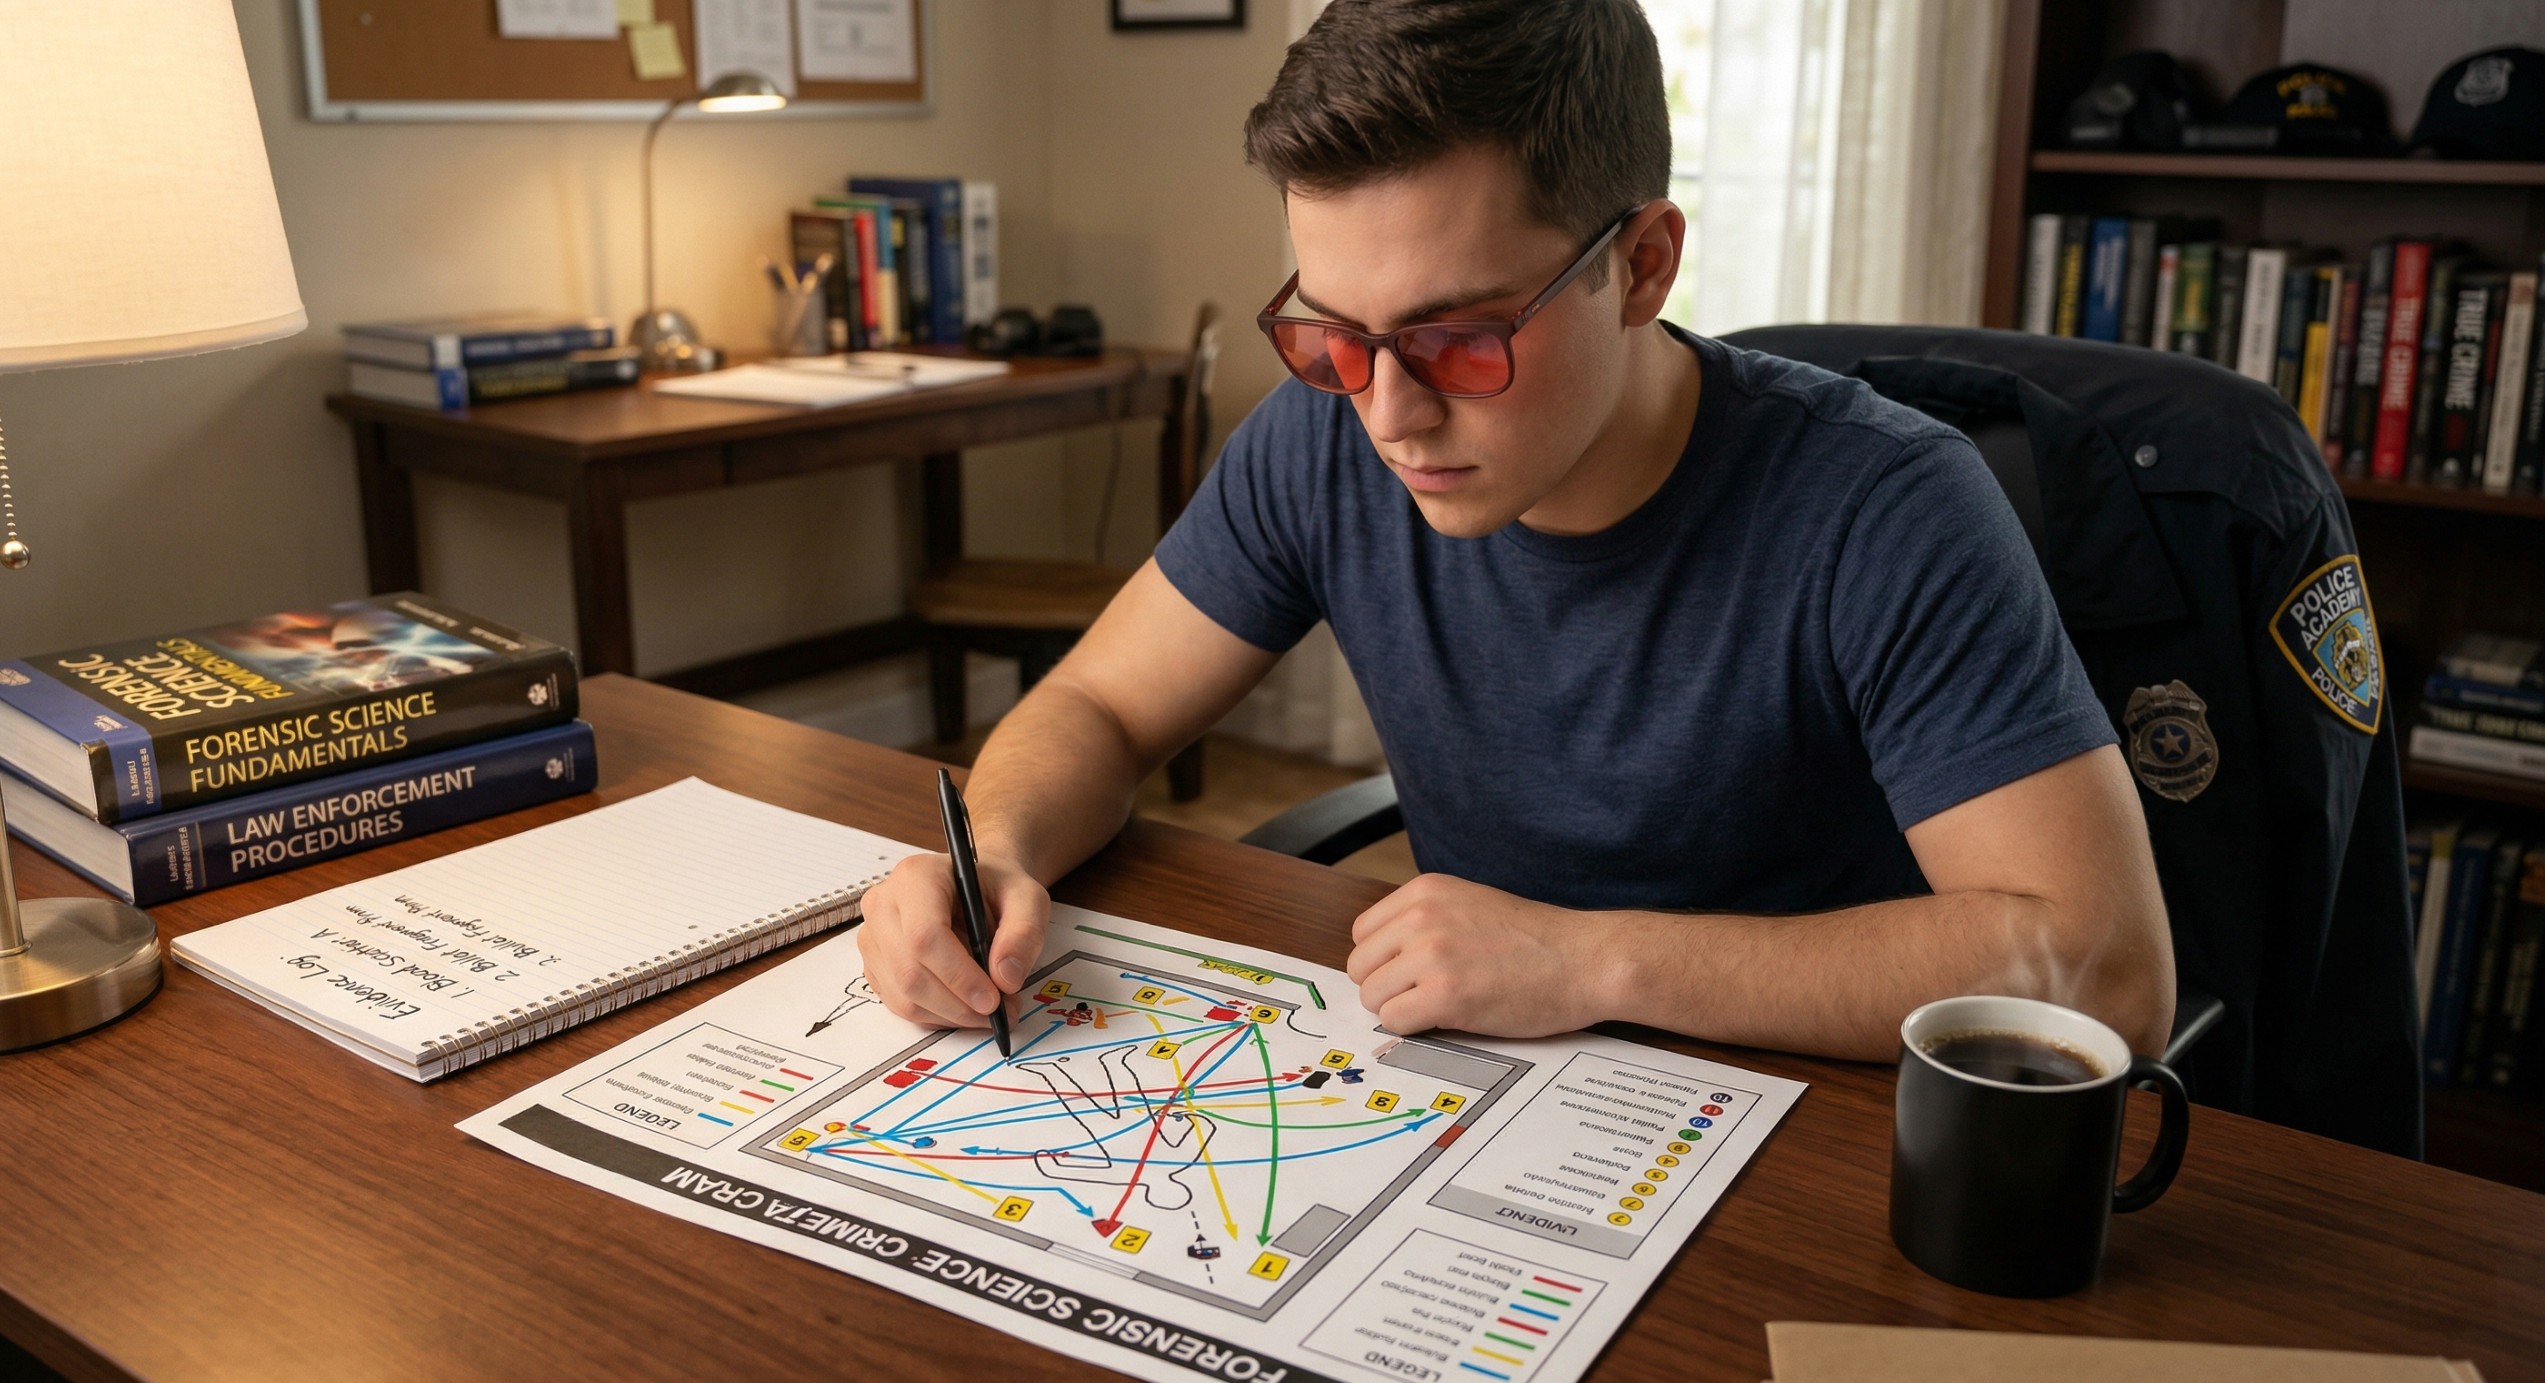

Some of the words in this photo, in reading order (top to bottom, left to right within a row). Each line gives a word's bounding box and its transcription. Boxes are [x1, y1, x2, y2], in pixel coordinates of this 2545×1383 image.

[2454, 289, 2488, 340] TRUE
[2445, 342, 2481, 410] CRIME
[2290, 566, 2355, 626] POLICE
[2300, 587, 2361, 650] ACADEMY
[58, 653, 202, 720] FORENSIC
[123, 652, 255, 708] SCIENCE
[2312, 667, 2360, 716] POLICE
[185, 714, 322, 764] FORENSIC
[328, 692, 437, 734] SCIENCE
[190, 726, 408, 793] FUNDAMENTALS
[227, 810, 285, 845] LAW
[292, 766, 476, 829] ENFORCEMENT
[231, 810, 405, 873] PROCEDURES
[660, 1166, 765, 1209] CRAM
[1082, 1309, 1288, 1383] FORENSIC
[1364, 1351, 1442, 1383] LEGEND
